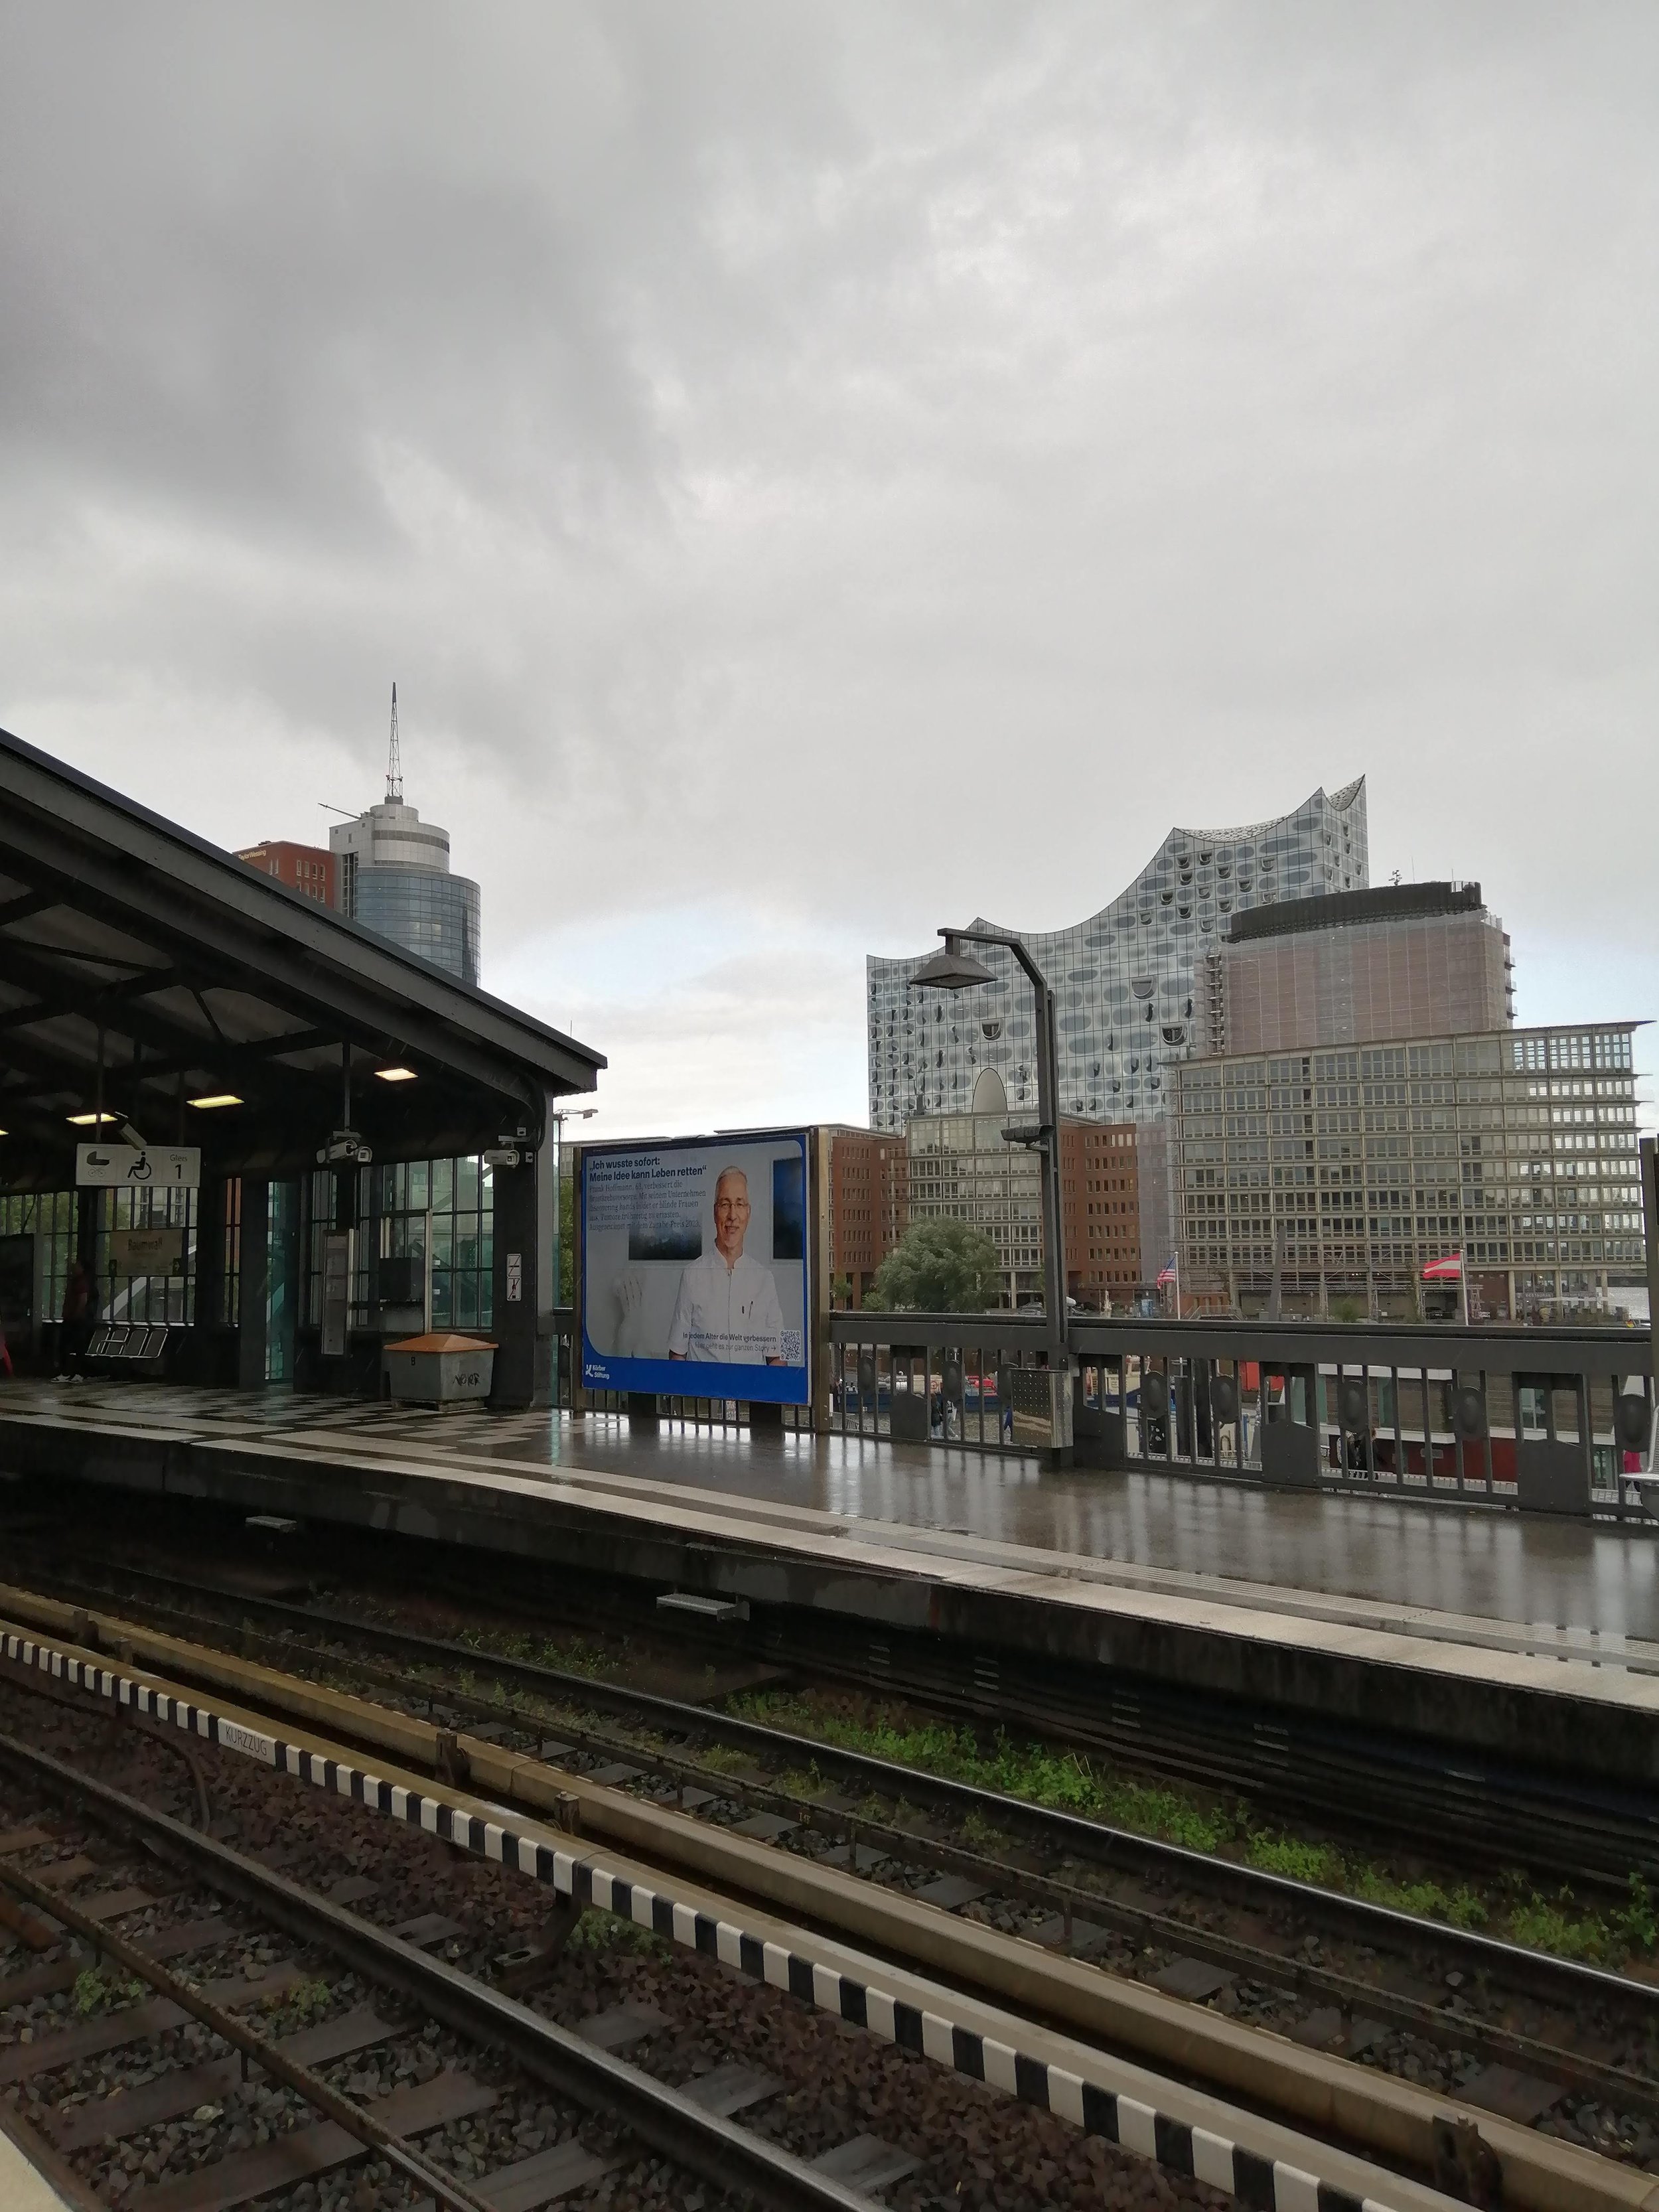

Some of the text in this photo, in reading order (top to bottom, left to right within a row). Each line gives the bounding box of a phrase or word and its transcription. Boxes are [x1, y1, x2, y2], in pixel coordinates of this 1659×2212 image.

[606, 1159, 633, 1169] wusste
[634, 1157, 660, 1167] sofort:
[175, 1164, 181, 1179] 1
[589, 1171, 613, 1182] Meine
[614, 1171, 630, 1181] Idee
[631, 1170, 650, 1179] kann
[652, 1168, 676, 1178] Leben
[668, 1189, 706, 1198] Unternehmen
[754, 1344, 770, 1353] Story
[226, 1726, 267, 1756] KURZZUG
